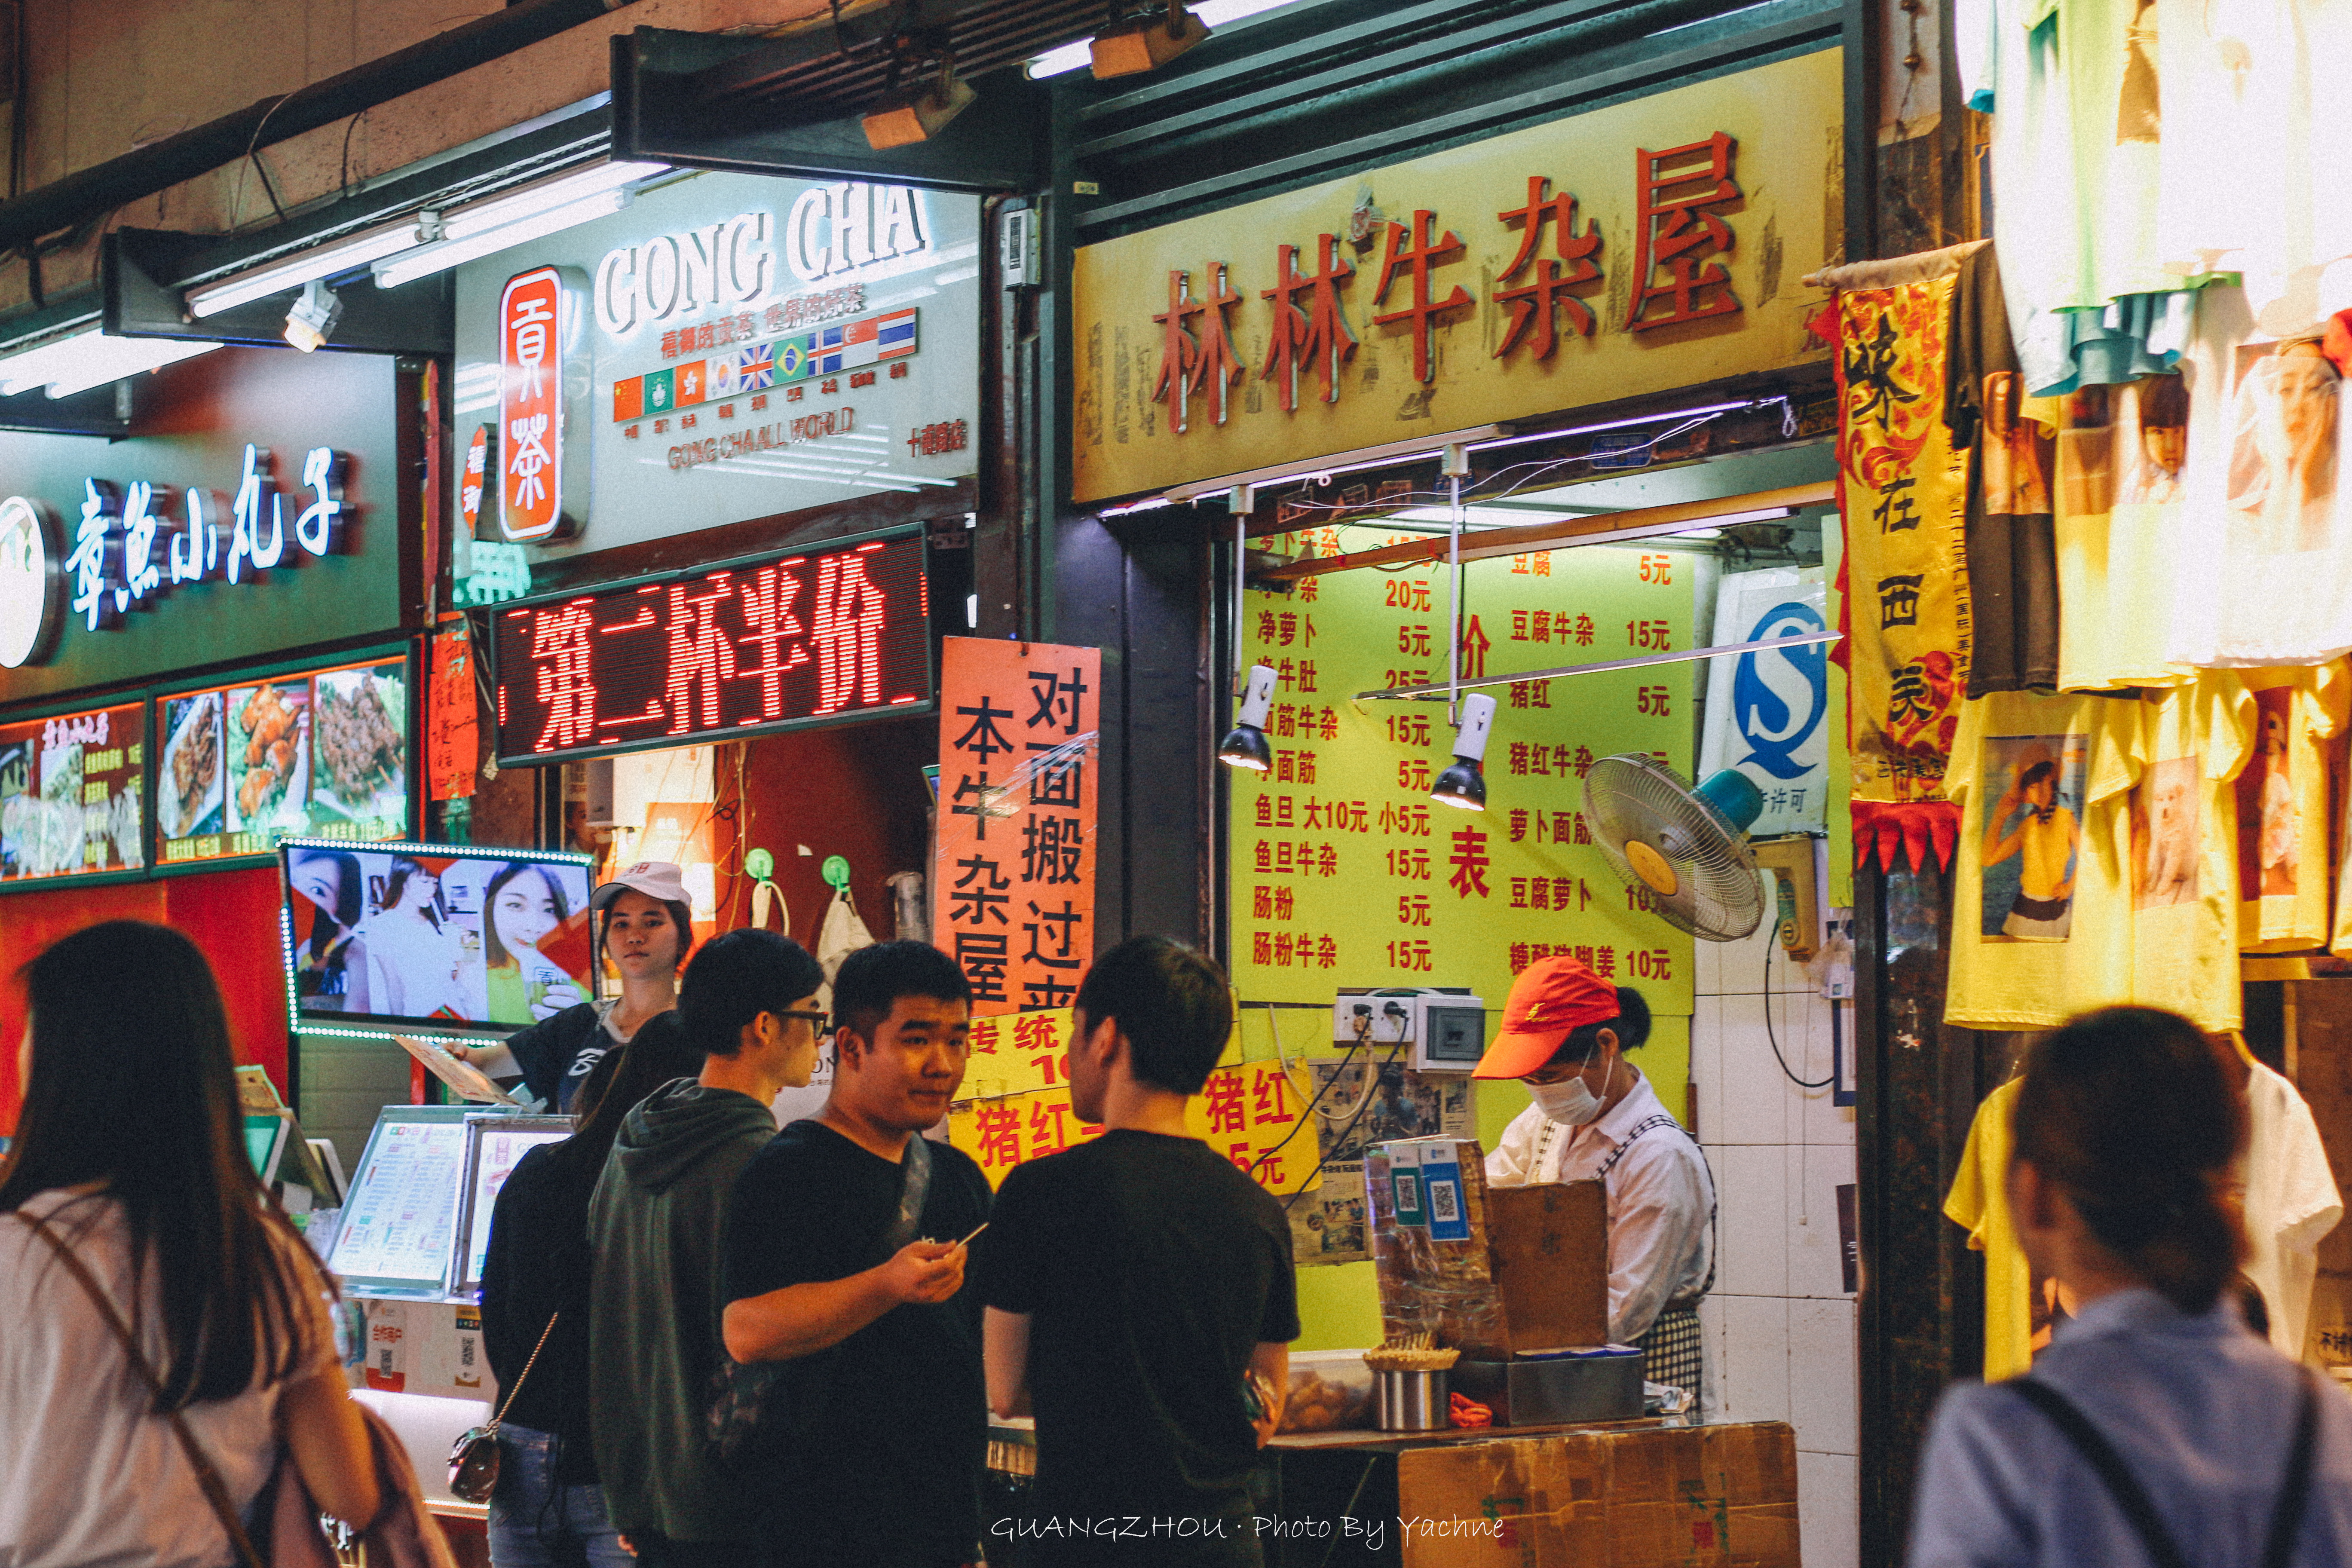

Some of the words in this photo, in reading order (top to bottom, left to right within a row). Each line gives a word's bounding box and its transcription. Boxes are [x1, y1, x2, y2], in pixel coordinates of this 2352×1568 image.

[594, 213, 769, 334] GONG
[786, 182, 931, 282] CHA
[1152, 130, 1745, 433] 林林牛杂屋
[668, 438, 716, 470] GONG
[789, 407, 853, 444] WORLD
[1639, 554, 1672, 585] 5元
[1385, 579, 1431, 612] 20元
[1257, 609, 1317, 648] 净萝卜
[1398, 625, 1431, 657] 5元
[1510, 609, 1594, 646] 豆腐牛杂
[1626, 620, 1671, 651] 15元
[532, 554, 885, 752] 第二杯半价
[1510, 680, 1551, 709] 猪红
[1637, 686, 1671, 717] 5元
[1387, 715, 1431, 747] 15元
[1398, 760, 1431, 792] 5元
[1510, 742, 1594, 779] 猪红牛杂
[1255, 793, 1295, 828] 鱼旦
[1303, 796, 1369, 833] 大10元
[1378, 801, 1431, 836] 小5元
[1510, 808, 1592, 845] 萝卜面筋
[950, 696, 1014, 1003] 本牛杂屋
[1254, 839, 1338, 878] 鱼旦牛杂
[1386, 848, 1431, 880] 15元
[1253, 885, 1294, 921] 肠粉
[1398, 894, 1432, 927] 5元
[1510, 876, 1592, 912] 豆腐萝卜
[1253, 931, 1337, 969] 肠粉牛杂
[1387, 940, 1432, 972] 15元
[1626, 949, 1672, 980] 10元
